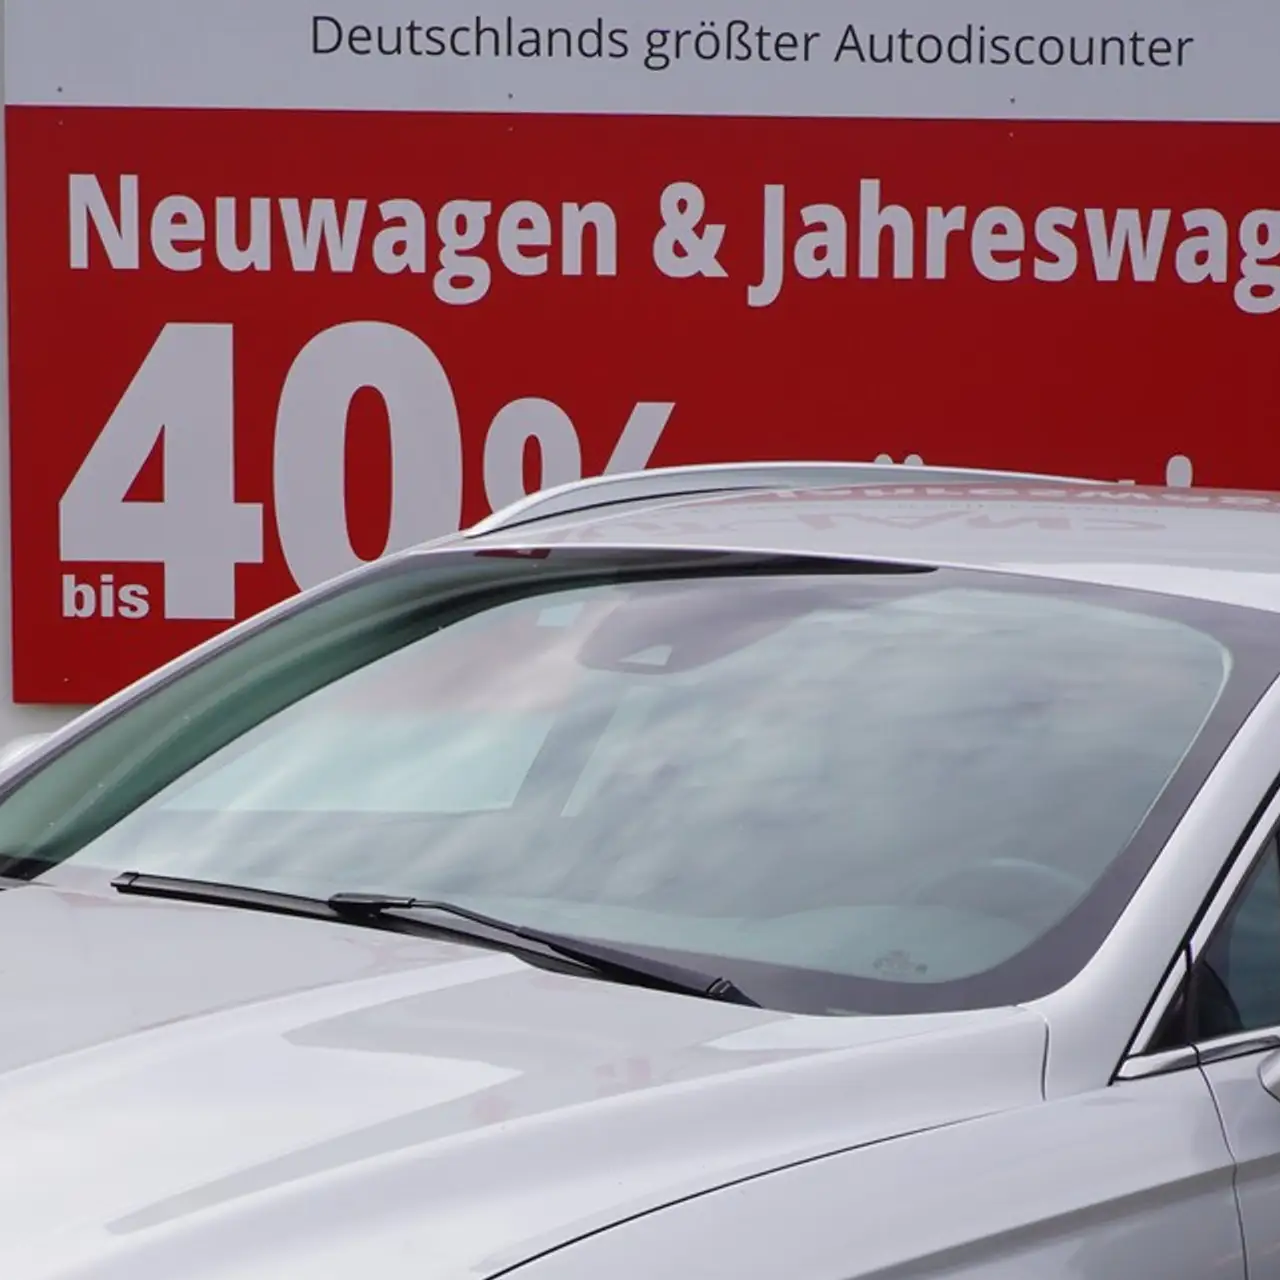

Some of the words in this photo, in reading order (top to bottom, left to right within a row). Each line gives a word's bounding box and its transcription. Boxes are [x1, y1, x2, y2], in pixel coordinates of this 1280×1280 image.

[312, 15, 629, 59] Deutschlands
[643, 19, 821, 70] größter
[833, 23, 1195, 67] Autodiscounter
[68, 173, 617, 305] Neuwagen
[652, 181, 729, 278] &
[62, 573, 150, 619] bis
